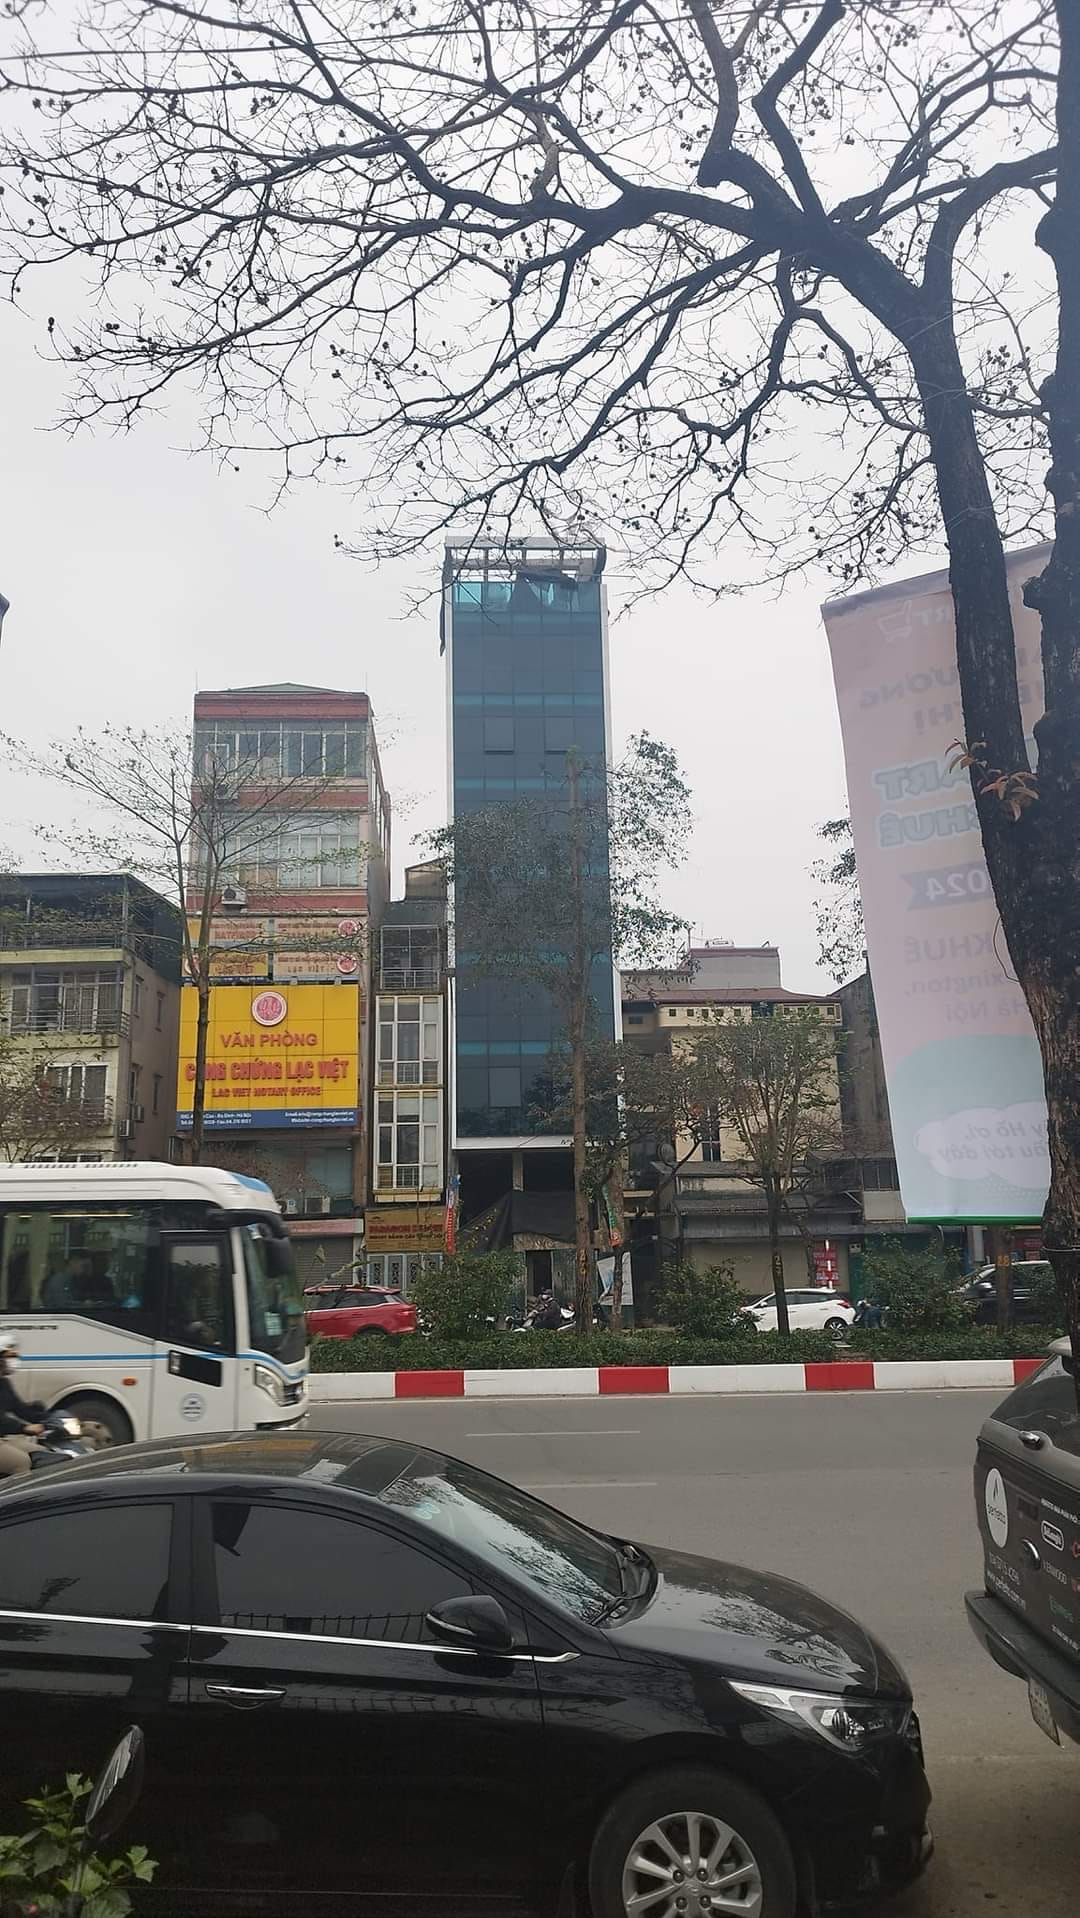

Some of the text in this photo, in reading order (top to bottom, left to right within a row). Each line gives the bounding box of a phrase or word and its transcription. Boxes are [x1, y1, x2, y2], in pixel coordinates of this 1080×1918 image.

[220, 1030, 319, 1048] VĂN PHÒNG
[185, 1058, 349, 1083] CNG CHỨNG LẠC VIỆT
[211, 1087, 230, 1098] LAC
[290, 1086, 321, 1097] OFFICE
